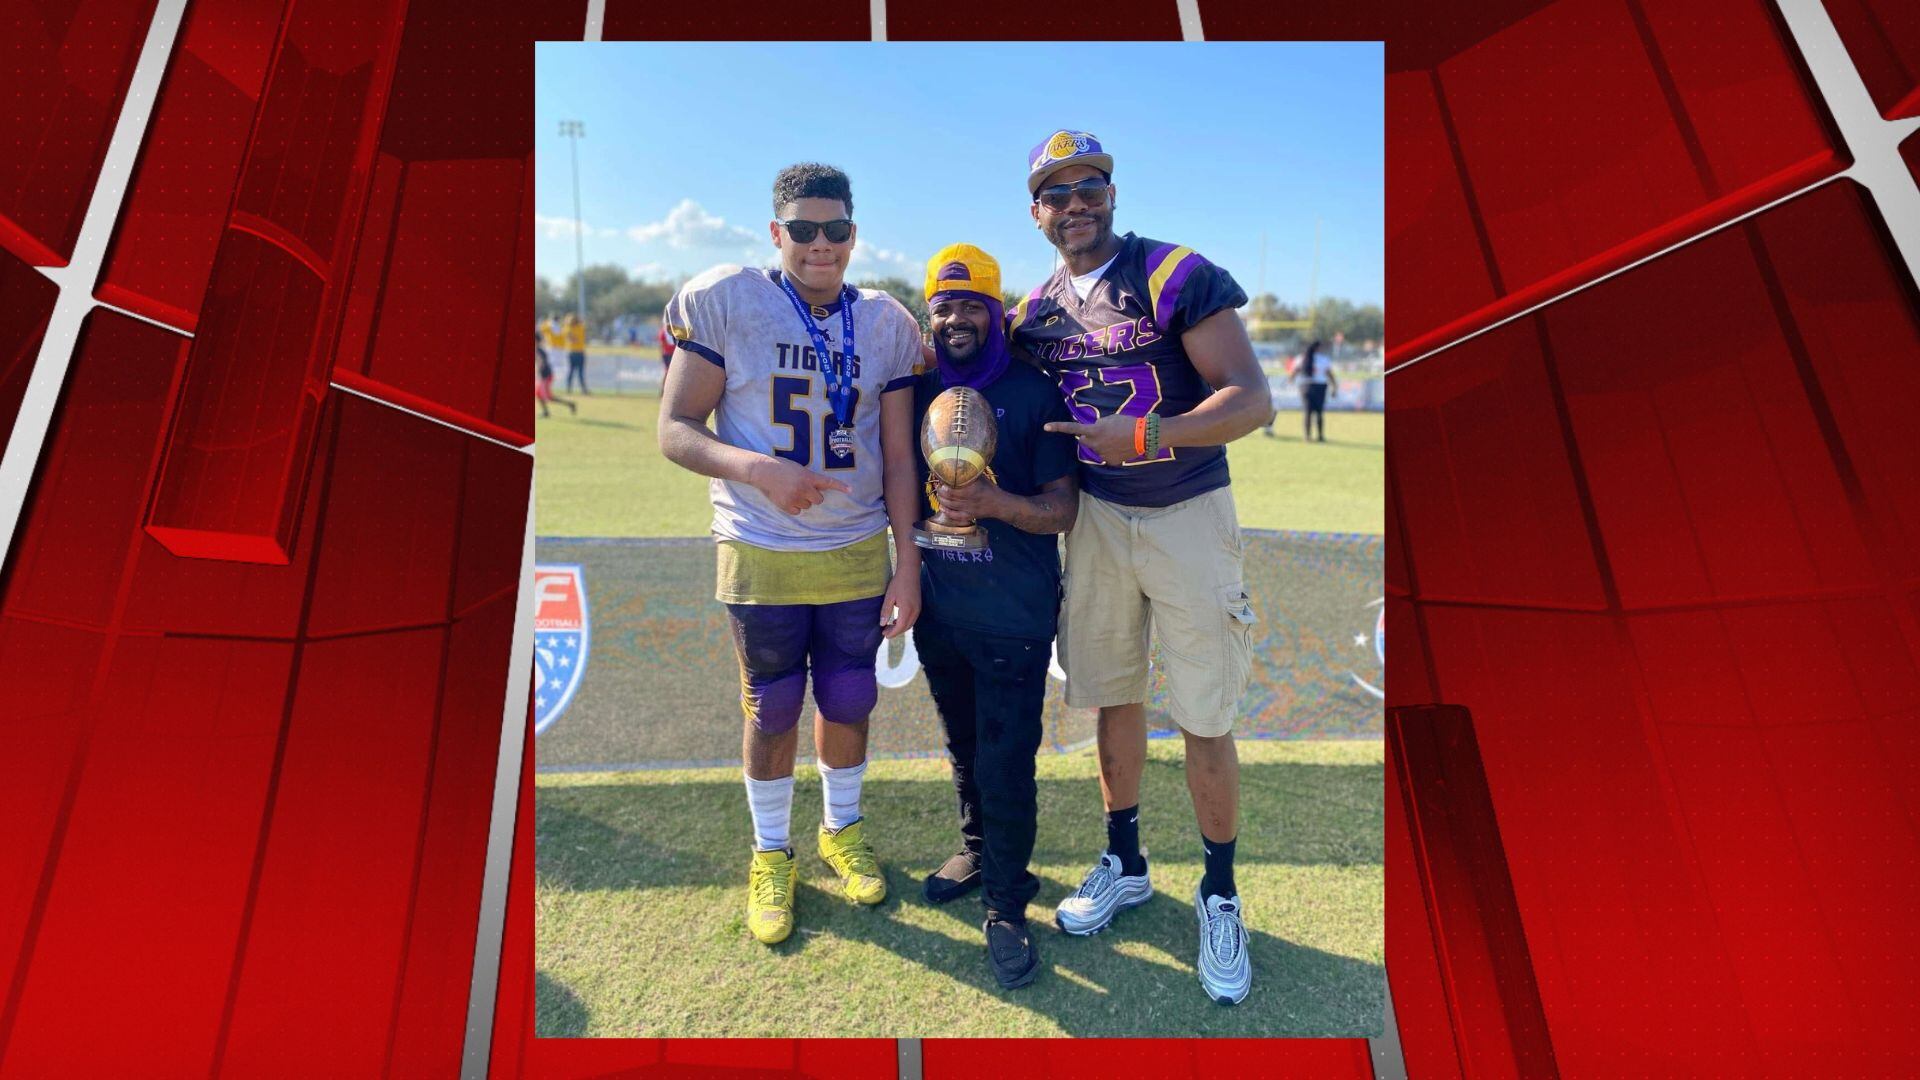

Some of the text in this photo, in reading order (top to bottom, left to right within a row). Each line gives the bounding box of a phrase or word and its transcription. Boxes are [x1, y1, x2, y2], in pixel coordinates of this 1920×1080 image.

[1037, 315, 1163, 362] TIGERS
[776, 342, 861, 380] TIGRS
[819, 351, 832, 374] 2021
[772, 374, 862, 471] 52
